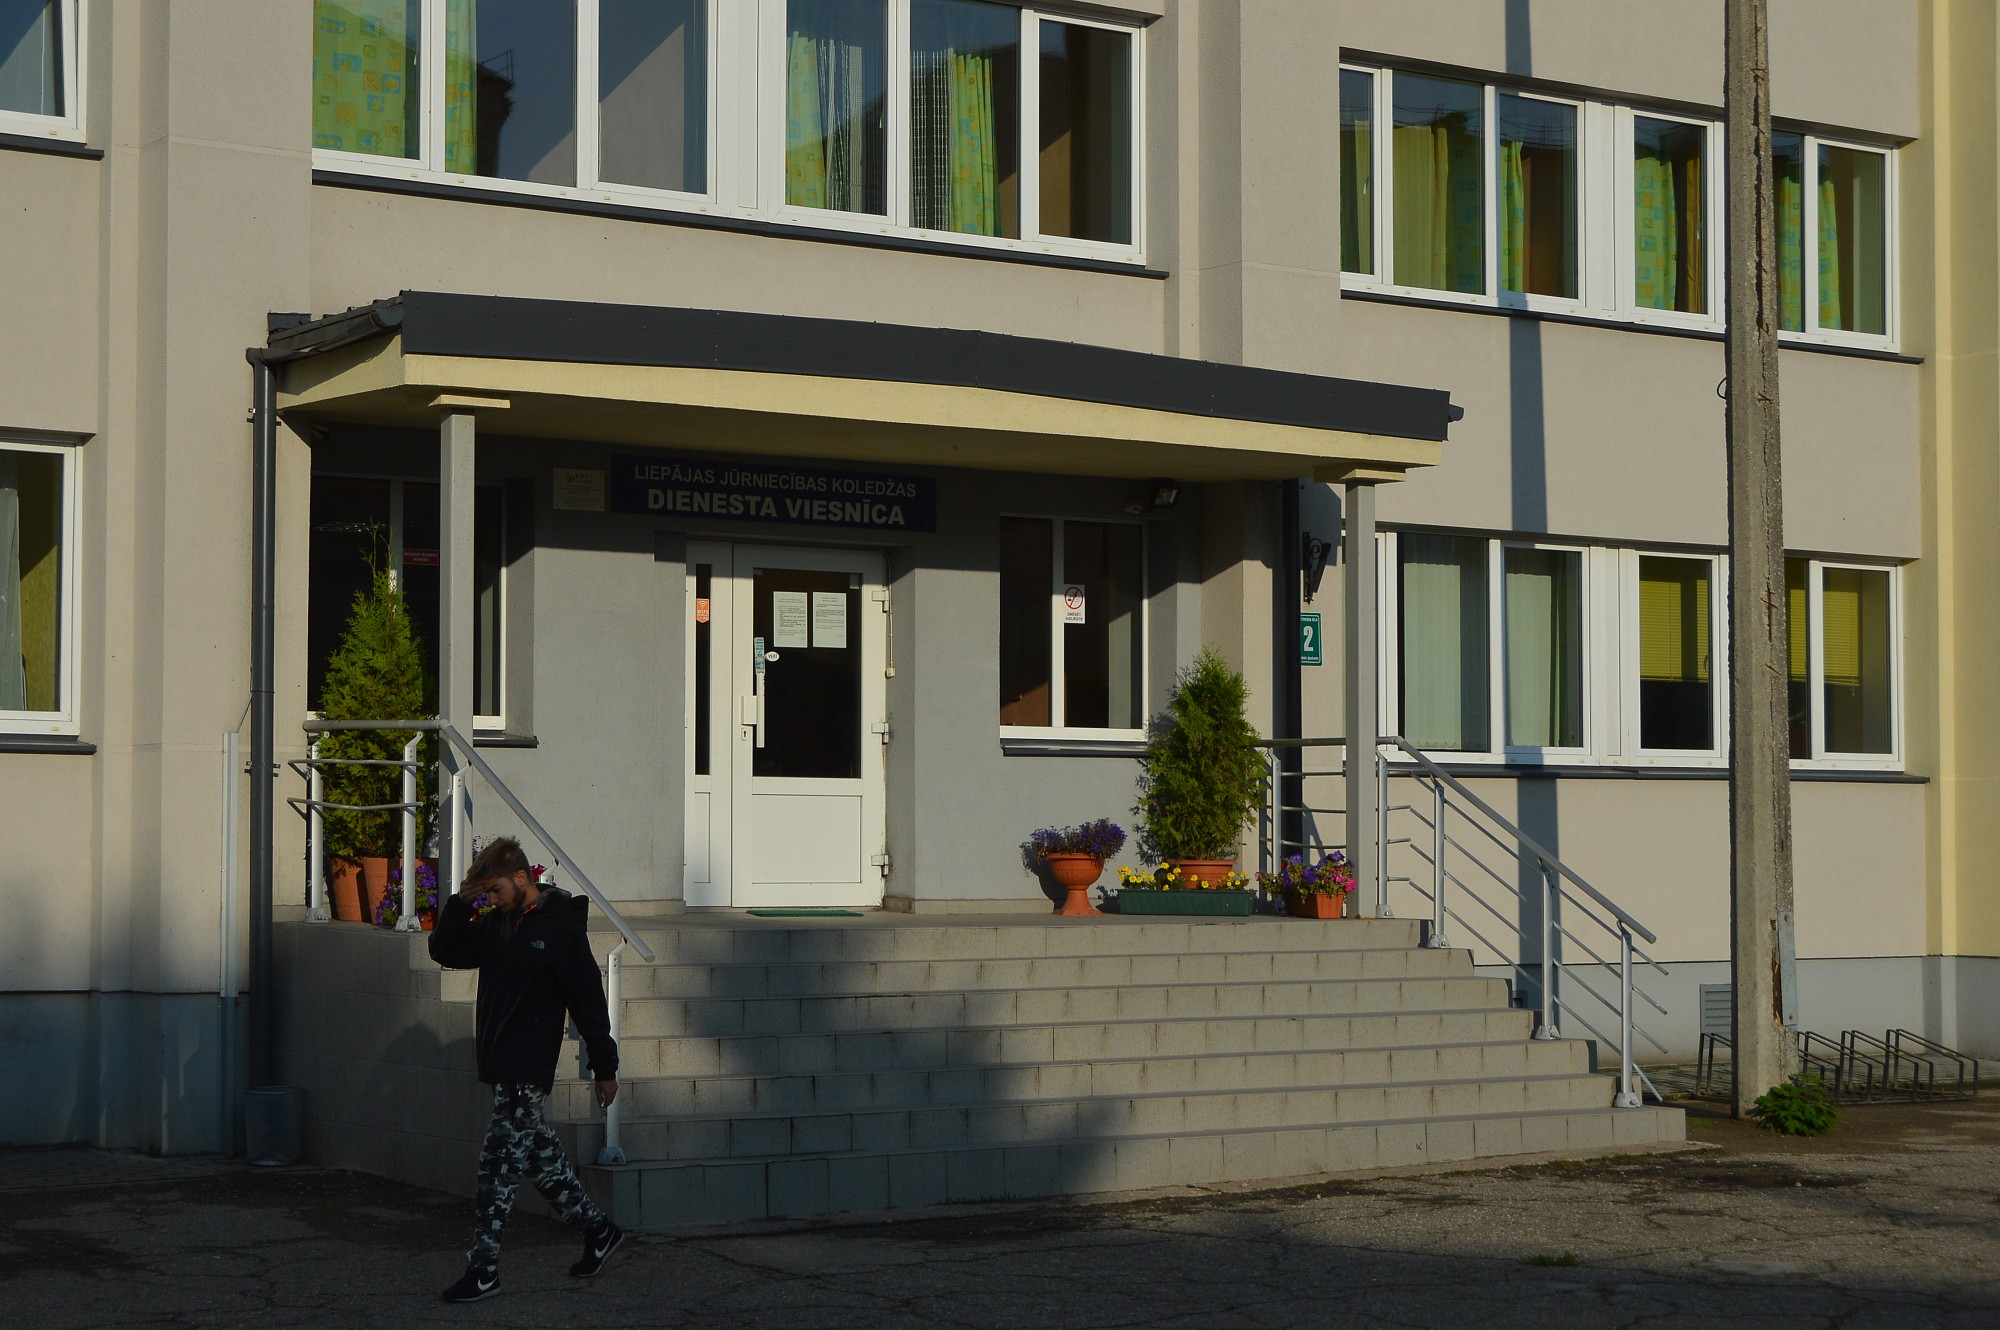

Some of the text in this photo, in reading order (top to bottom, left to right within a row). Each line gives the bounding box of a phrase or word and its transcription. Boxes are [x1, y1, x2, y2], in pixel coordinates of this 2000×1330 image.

[635, 464, 917, 498] LIEPĀJAS JŪRNIECĪBAS KOLEDŽAS
[648, 488, 905, 525] DIENESTA VIESNĪCA
[1303, 625, 1314, 652] 2
